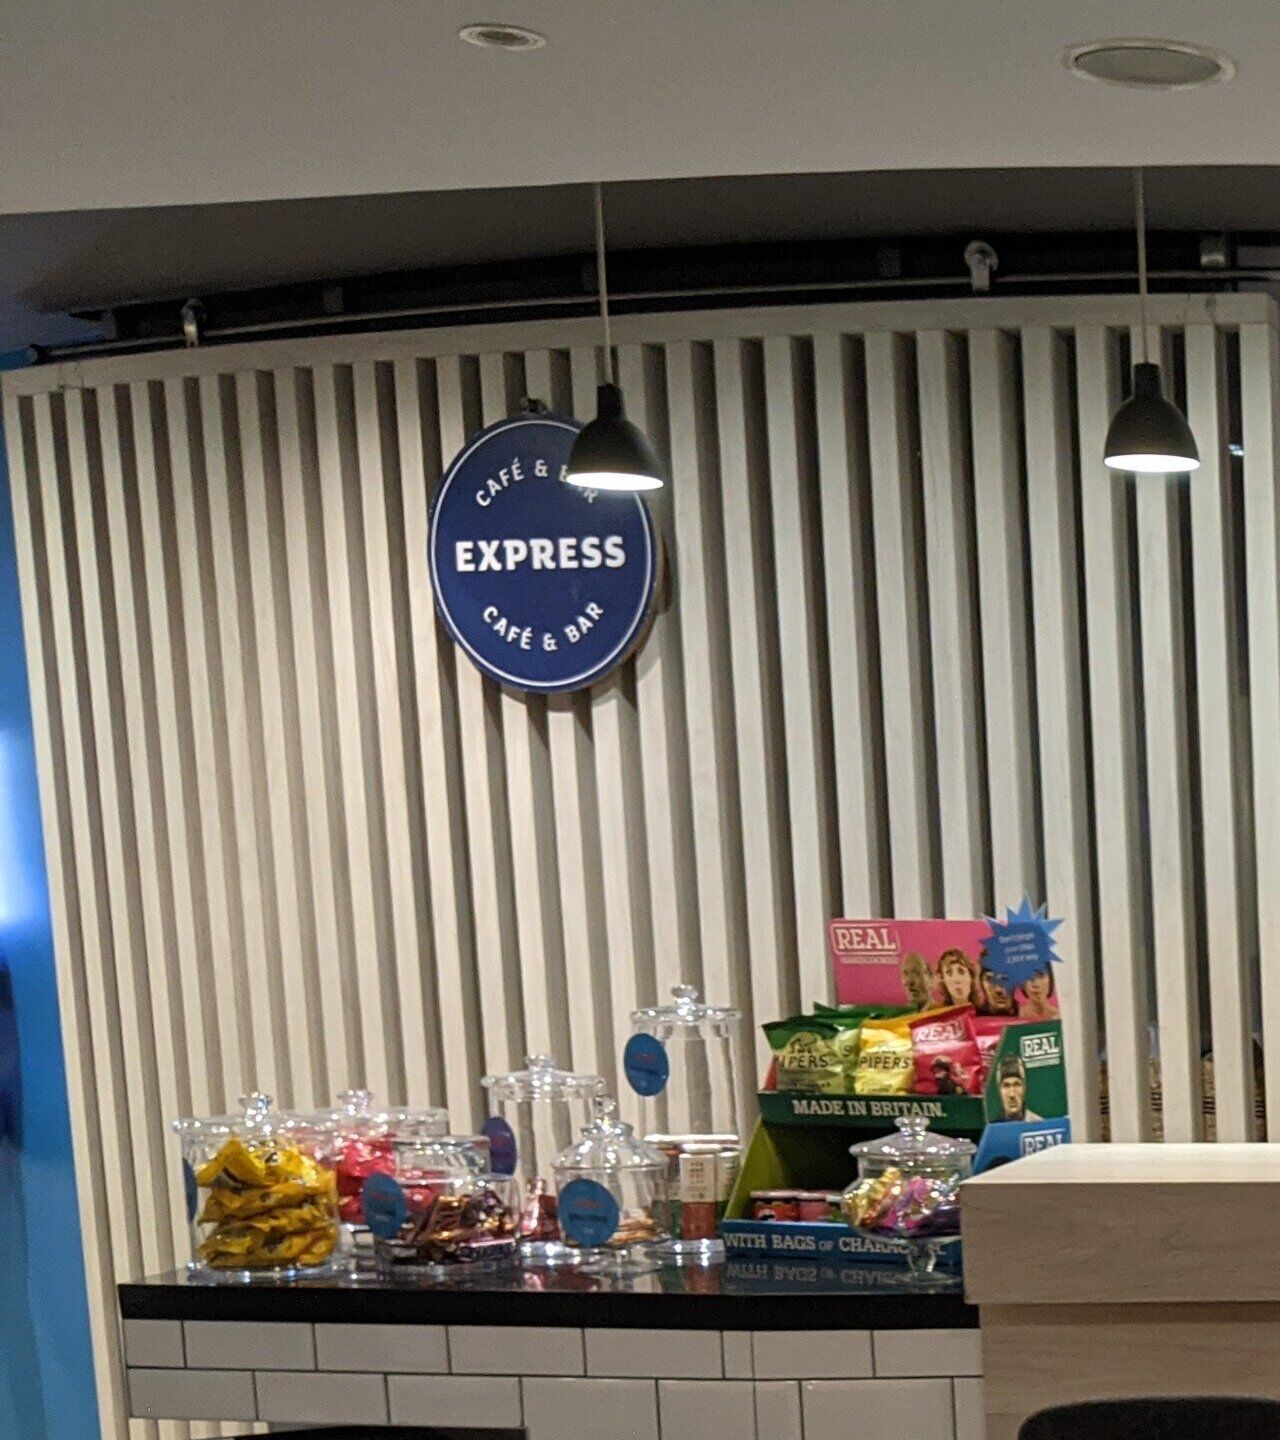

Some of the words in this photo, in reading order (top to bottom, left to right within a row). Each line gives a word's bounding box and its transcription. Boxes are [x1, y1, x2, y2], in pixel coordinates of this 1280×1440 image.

[475, 457, 525, 507] CAFÉ
[534, 459, 549, 478] &
[559, 464, 599, 503] BR
[455, 535, 626, 572] EXPRESS
[482, 605, 532, 650] CAFÉ
[542, 633, 558, 651] &
[564, 601, 604, 643] BAR
[834, 927, 897, 950] REAL
[1023, 1036, 1061, 1057] REAL
[860, 1056, 911, 1069] PIPERS
[791, 1099, 845, 1115] MADE
[846, 1101, 867, 1116] IN
[870, 1101, 948, 1118] BRITAIN.
[724, 1232, 767, 1249] WITH
[771, 1234, 816, 1251] BAGS
